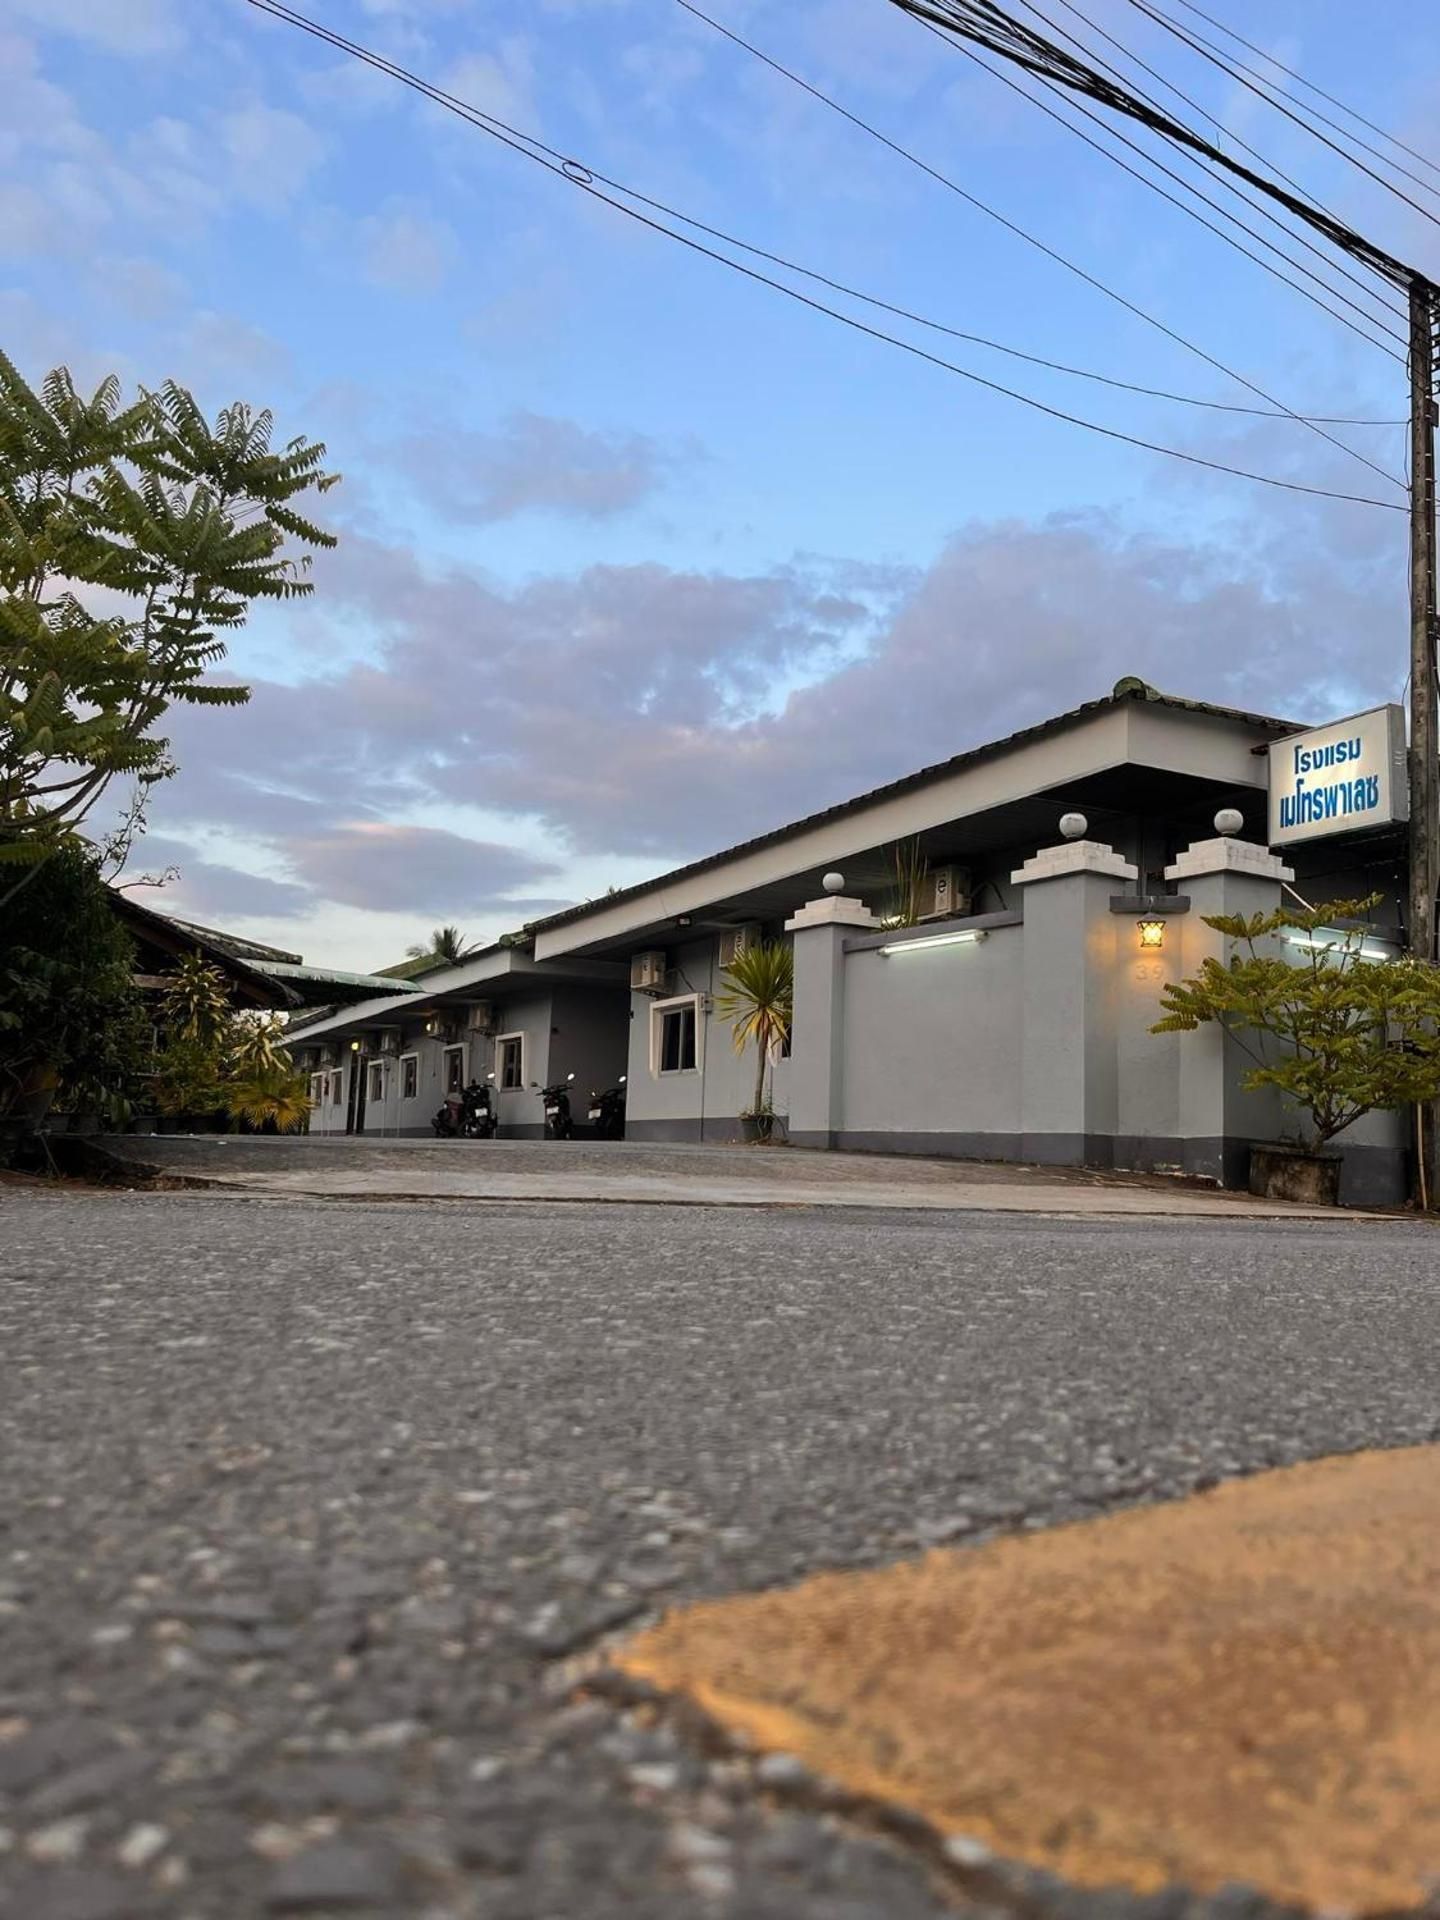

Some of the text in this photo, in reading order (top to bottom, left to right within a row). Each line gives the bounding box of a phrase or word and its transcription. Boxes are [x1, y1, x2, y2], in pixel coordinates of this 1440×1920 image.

[1294, 738, 1361, 774] โรงแรม
[1280, 775, 1379, 828] เมโทรพาเลซ
